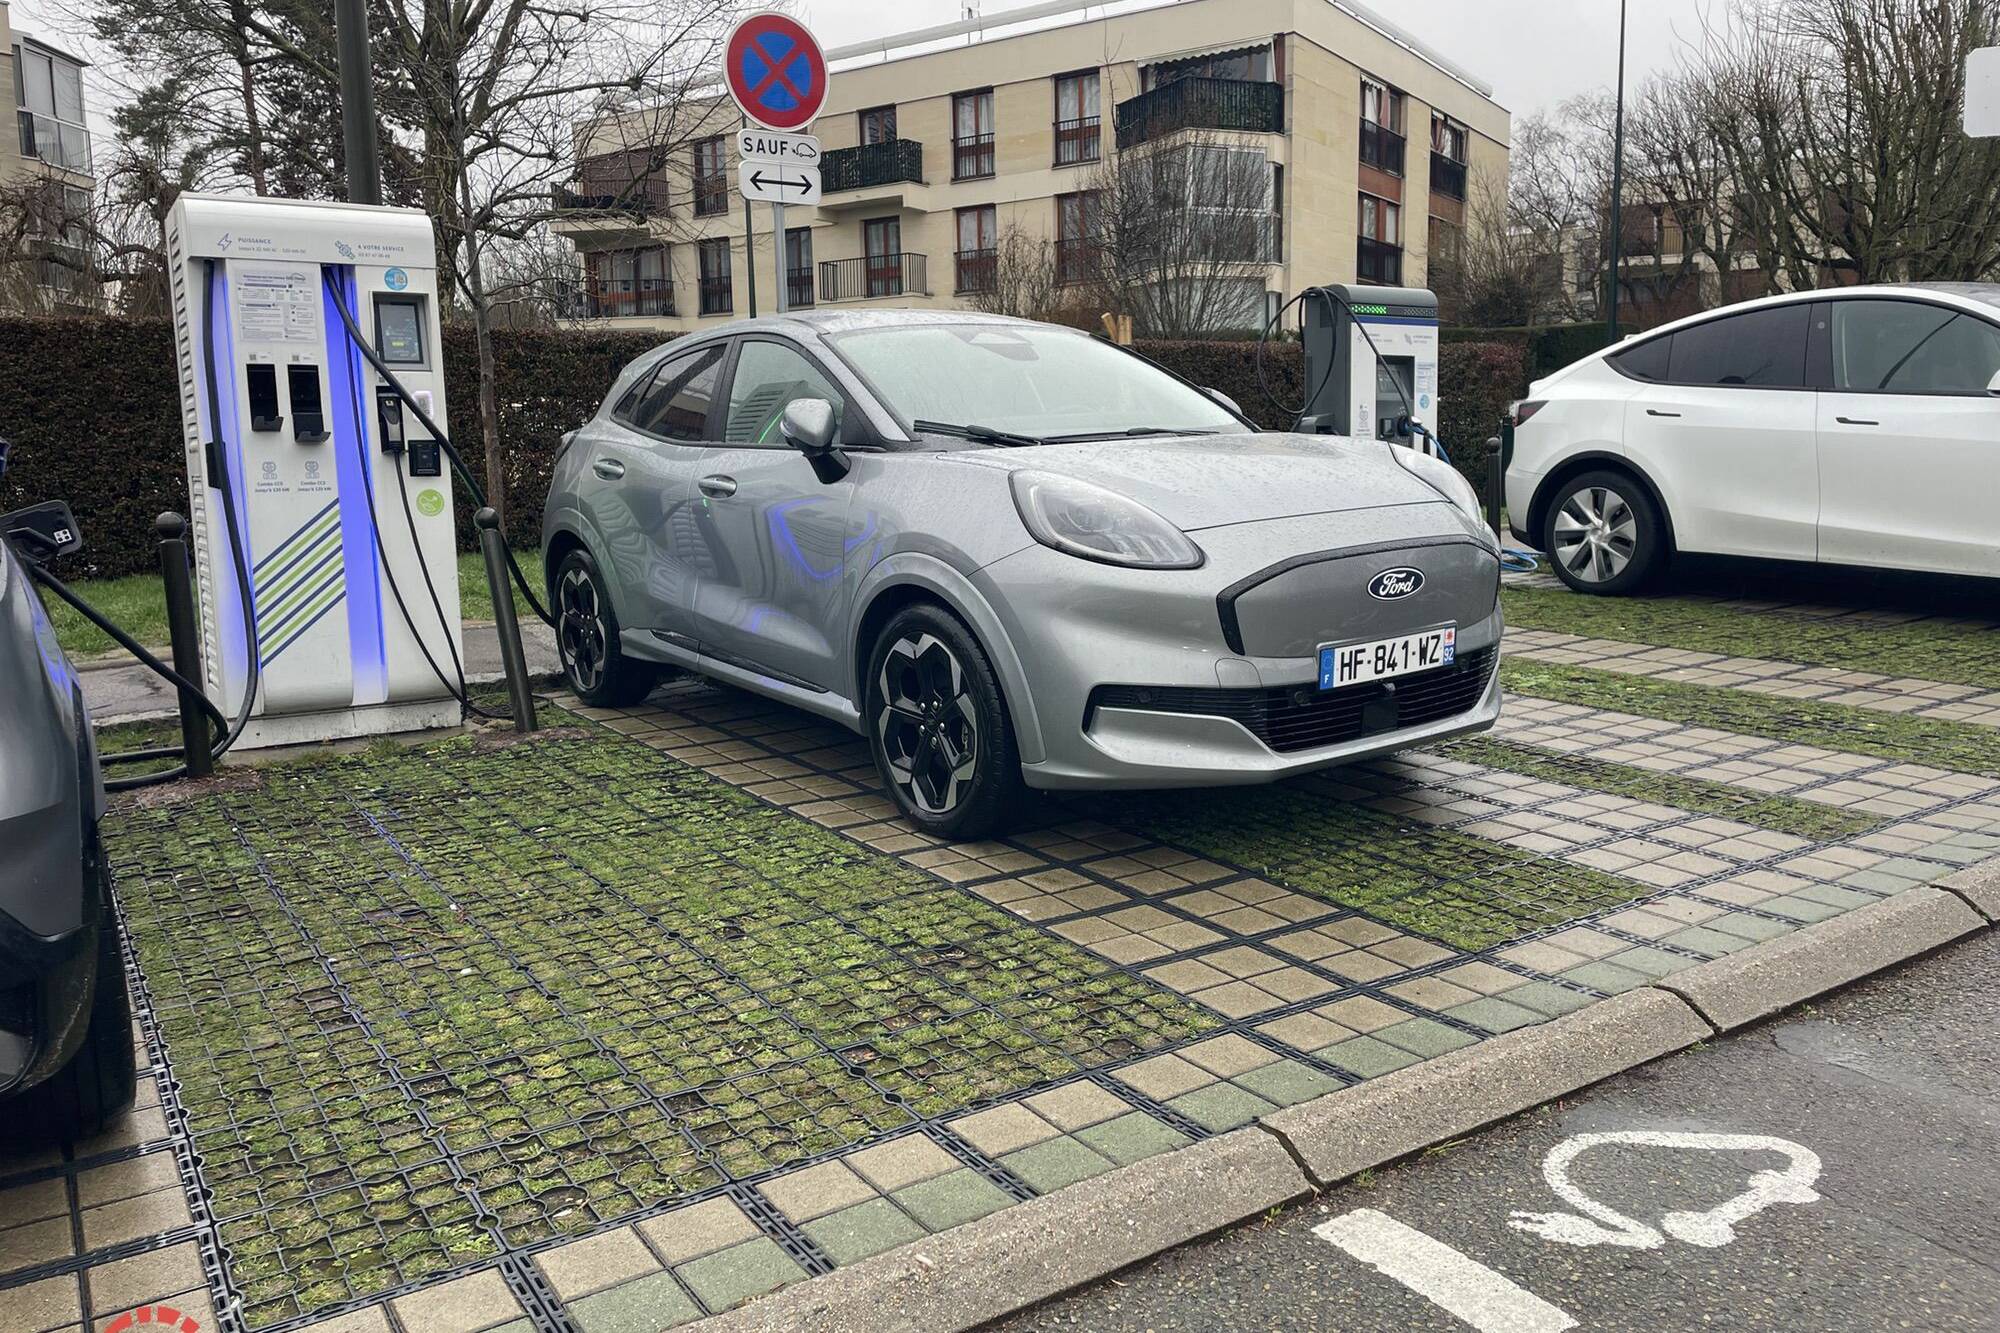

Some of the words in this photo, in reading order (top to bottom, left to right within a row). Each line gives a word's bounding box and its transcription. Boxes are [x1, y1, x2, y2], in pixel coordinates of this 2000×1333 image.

[743, 136, 788, 156] SAUF
[1379, 571, 1415, 596] Ford
[1340, 633, 1441, 682] HF-841-WZ
[1443, 646, 1455, 662] 92
[1324, 673, 1330, 685] F
